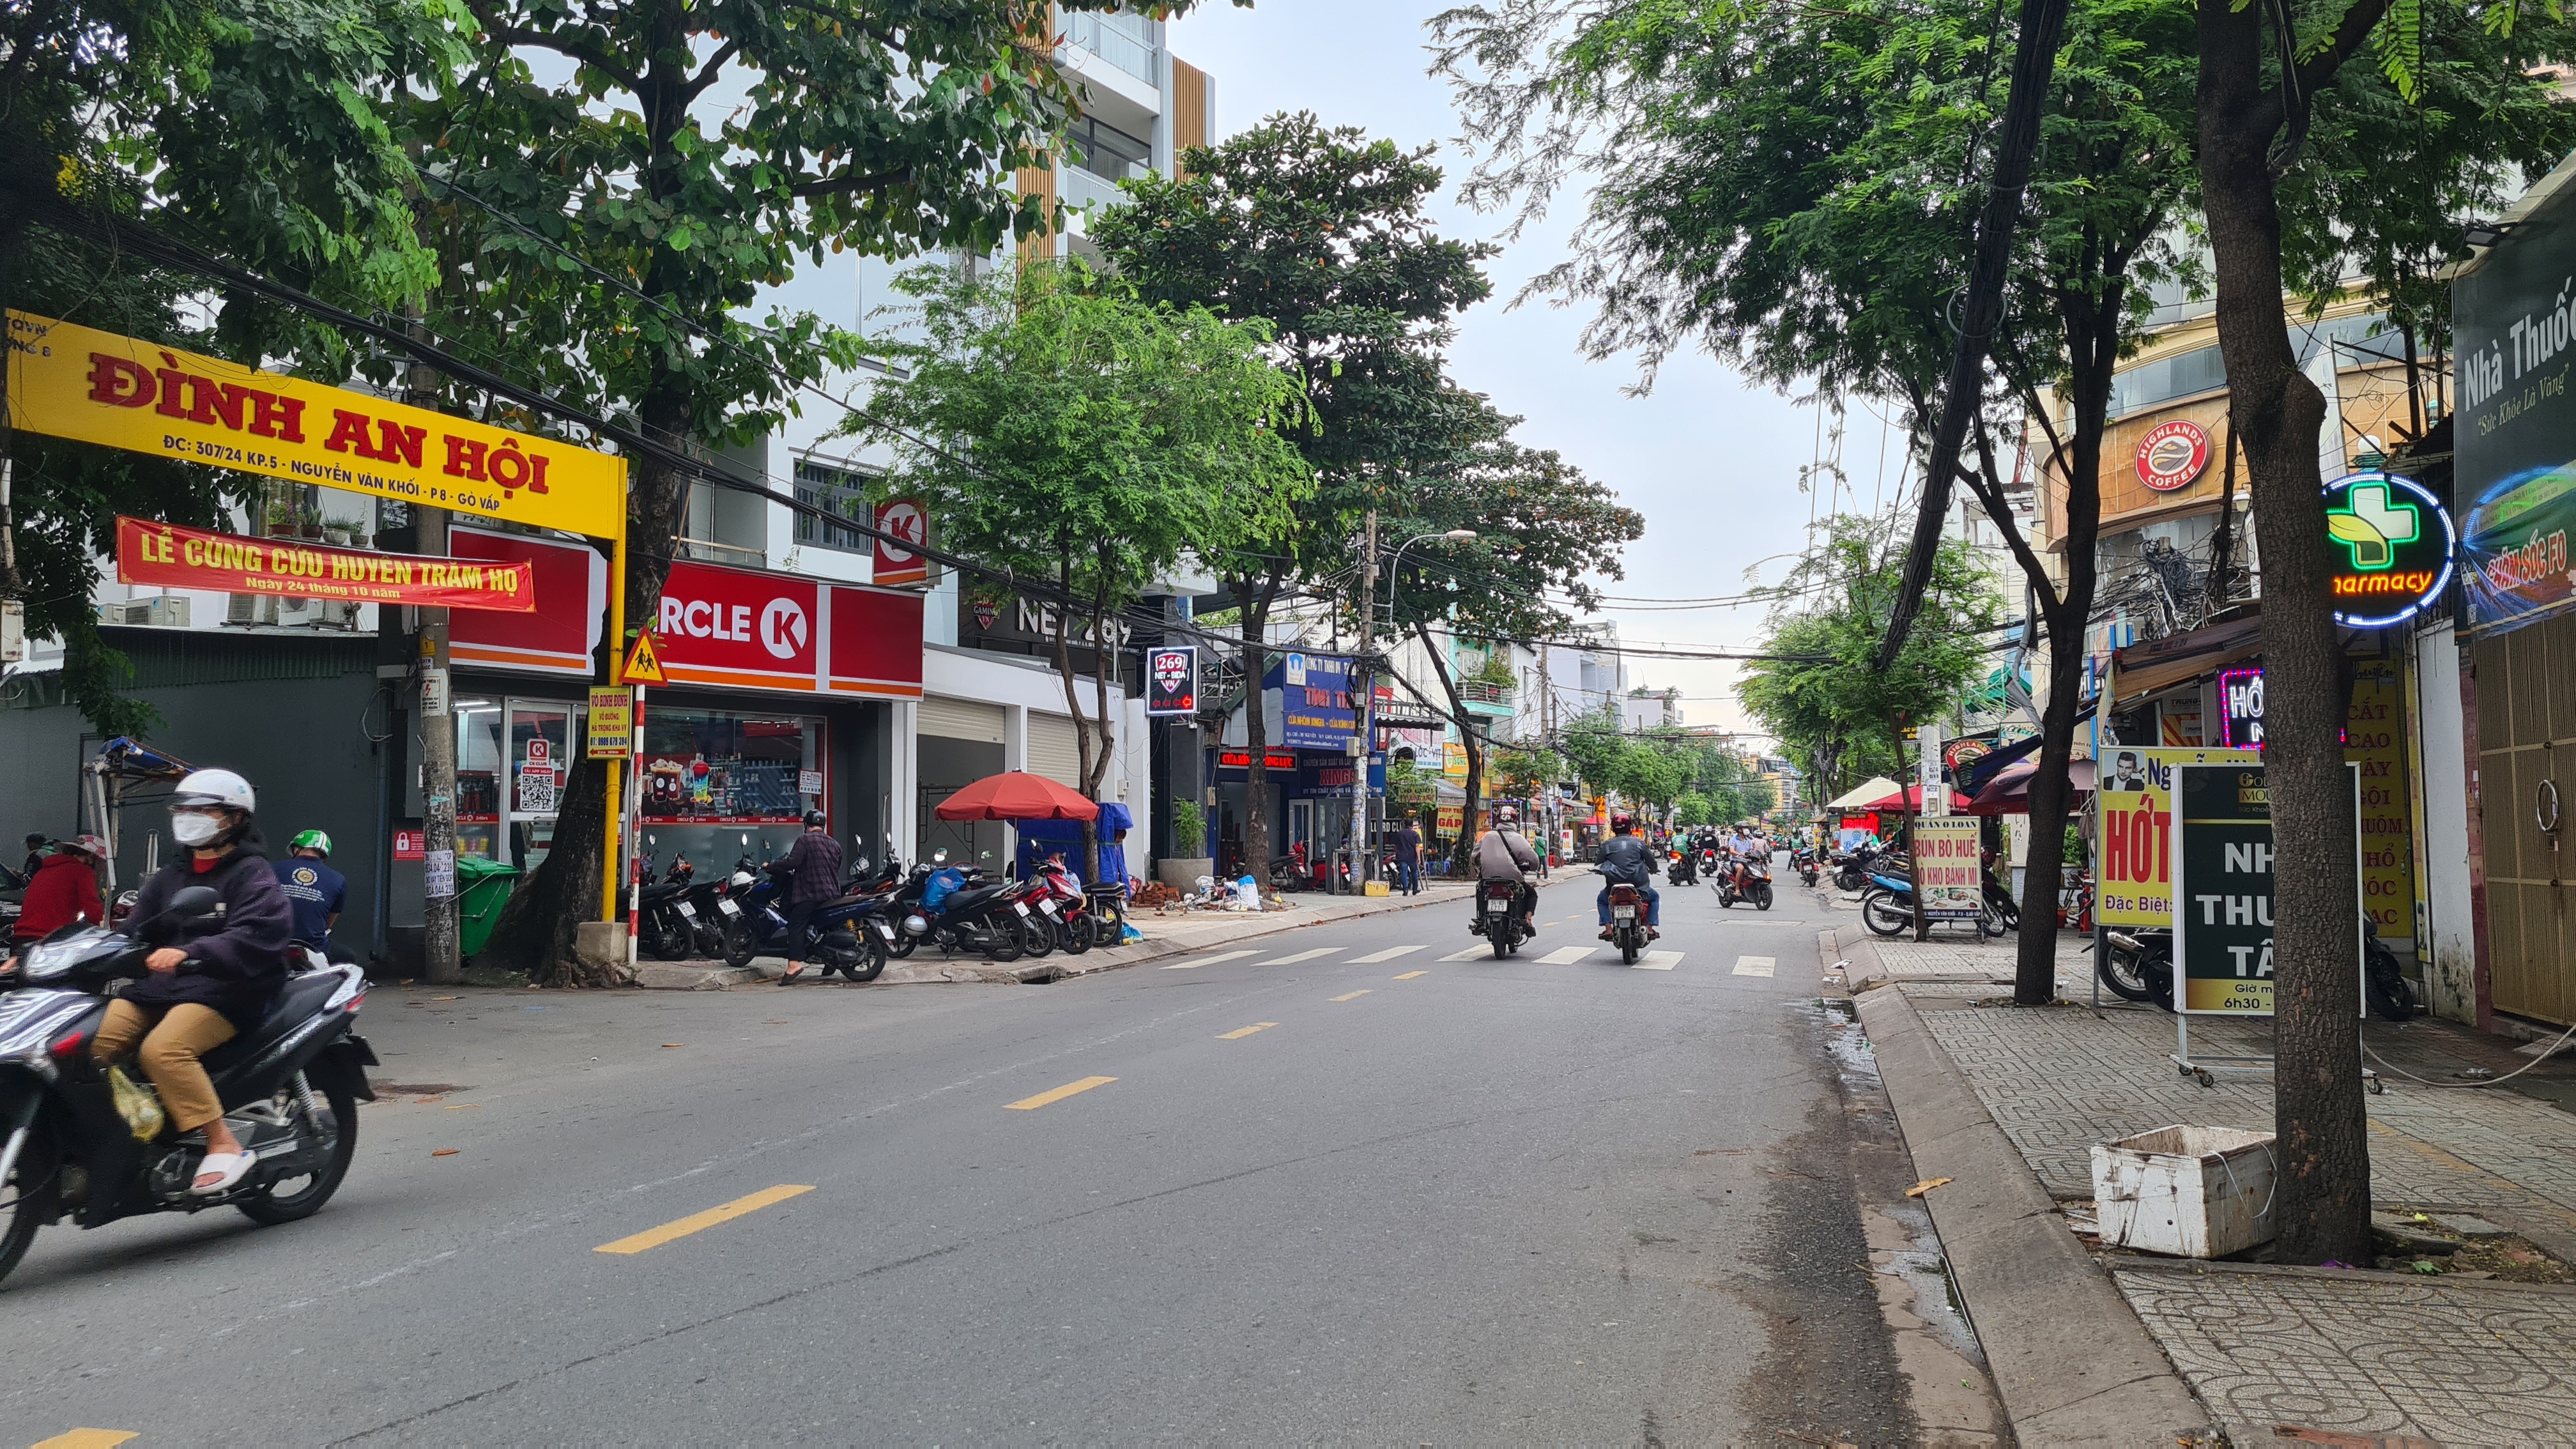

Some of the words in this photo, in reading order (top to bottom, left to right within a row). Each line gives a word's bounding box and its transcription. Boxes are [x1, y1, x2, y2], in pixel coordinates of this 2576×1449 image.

[42, 346, 50, 357] 8
[2465, 339, 2503, 413] Nhà
[2499, 396, 2521, 425] Khỏe
[2524, 386, 2536, 411] Là
[88, 351, 305, 444] ĐÌNH
[324, 408, 427, 468] AN
[443, 437, 549, 499] HỘI
[2140, 424, 2203, 459] HIGHLANDS
[163, 434, 192, 452] ĐC:
[196, 441, 242, 462] 307/24
[247, 451, 277, 468] KP.5
[291, 460, 352, 484] NGUYỄN
[357, 472, 383, 489] VĂN
[388, 477, 419, 496] KHỐI
[458, 491, 476, 507] GÒ
[480, 494, 500, 511] VẤP
[2148, 464, 2196, 486] COFFEE
[141, 526, 175, 564] LỄ
[184, 536, 263, 572] CÚNG
[418, 560, 483, 590] TRĂM
[489, 568, 518, 597] HỌ
[245, 577, 283, 591] Ngày
[288, 581, 305, 592] 24
[308, 582, 348, 595] tháng
[351, 586, 369, 596] 10
[372, 588, 401, 599] năm
[1159, 657, 1183, 670] 269
[1306, 656, 1317, 671] CÔNG
[1317, 659, 1323, 672] TY
[1324, 660, 1335, 674] TNHH
[1154, 671, 1167, 680] NET
[1170, 671, 1186, 679] BIDA
[2348, 733, 2391, 752] CẠO
[1222, 752, 1238, 765] CỬA
[1238, 753, 1250, 765] KÍN
[1438, 815, 1462, 828] GẤP
[1914, 820, 1940, 830] QUÁN
[1914, 834, 1935, 857] BÚN
[1938, 834, 1952, 857] BÒ
[1956, 832, 1977, 857] HUẾ
[2225, 843, 2274, 873] NH
[1928, 867, 1943, 885] KHO
[1945, 862, 1965, 885] BÁNH
[1968, 862, 1977, 885] MÌ
[2105, 894, 2133, 914] Đặc
[2140, 896, 2173, 916] Biệt:
[2235, 984, 2257, 994] Giờ
[2262, 986, 2274, 994] m
[2225, 998, 2260, 1009] 6h30
